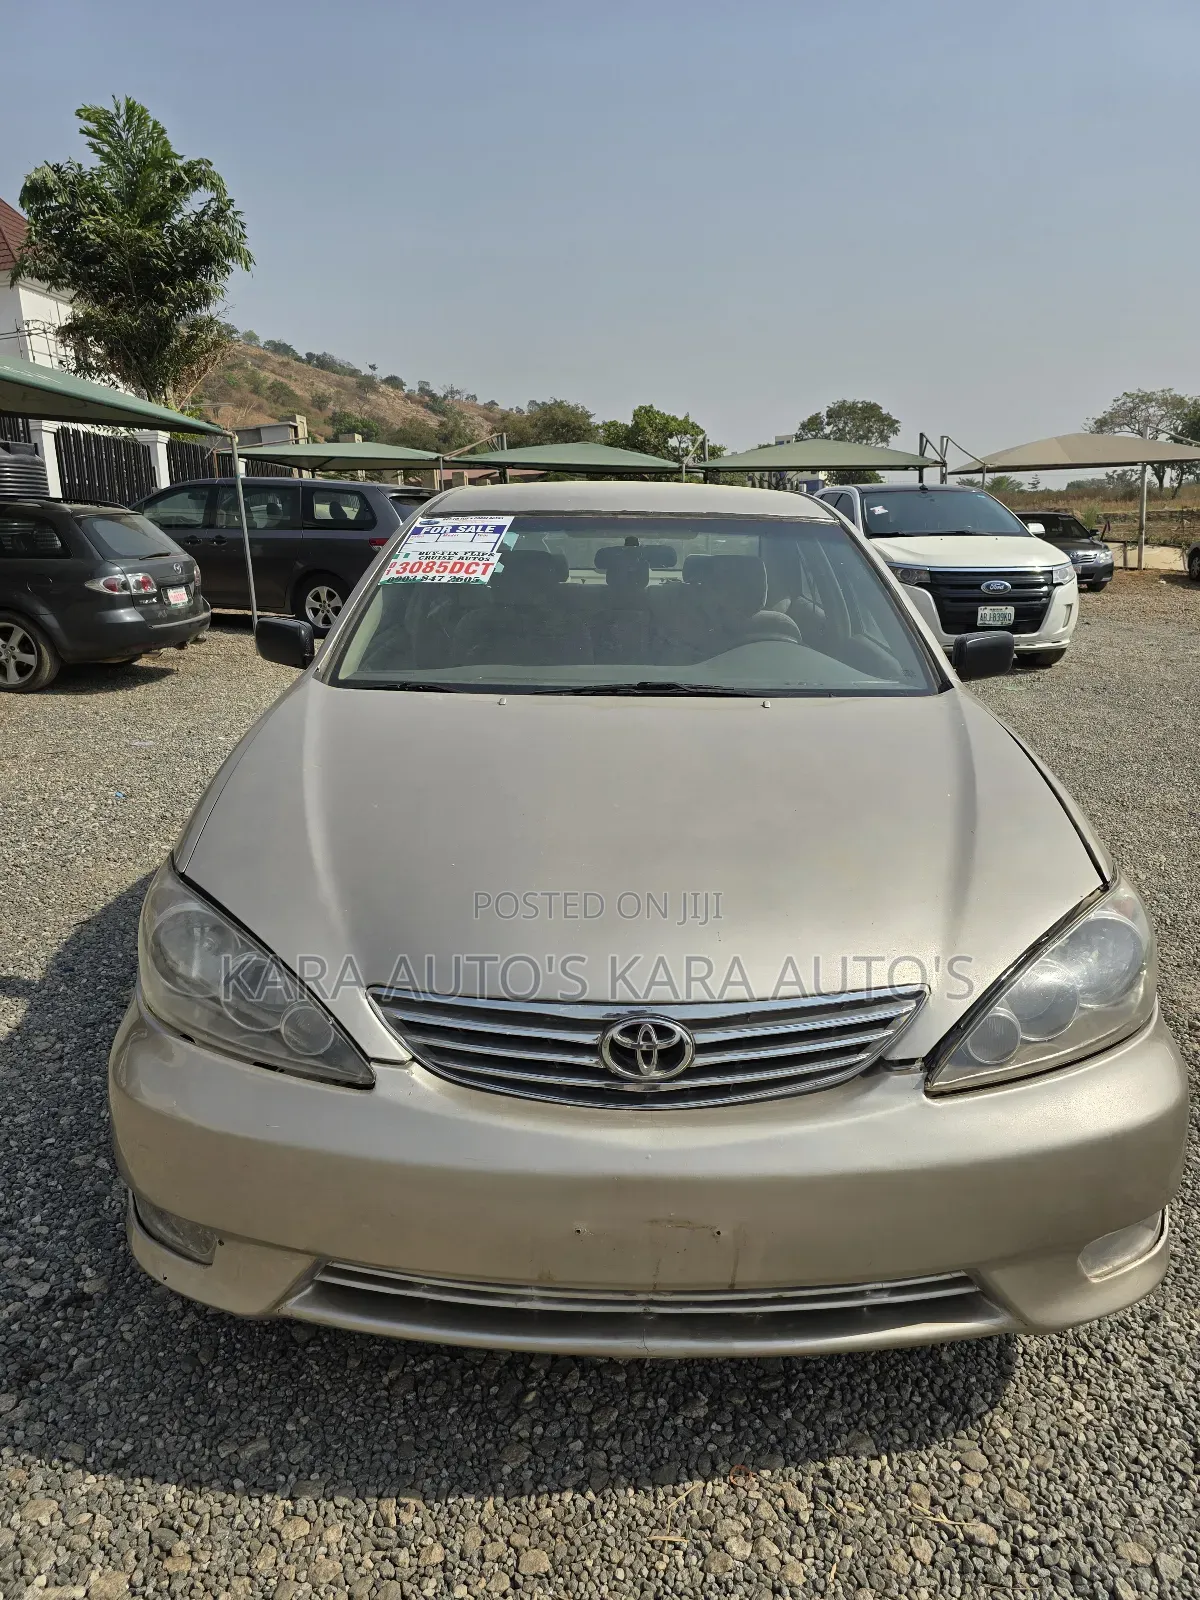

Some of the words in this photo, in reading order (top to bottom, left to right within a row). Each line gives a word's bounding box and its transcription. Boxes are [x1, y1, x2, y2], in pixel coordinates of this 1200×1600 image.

[421, 526, 452, 534] FOR
[456, 525, 497, 533] SALE
[396, 560, 495, 576] 3085DCT
